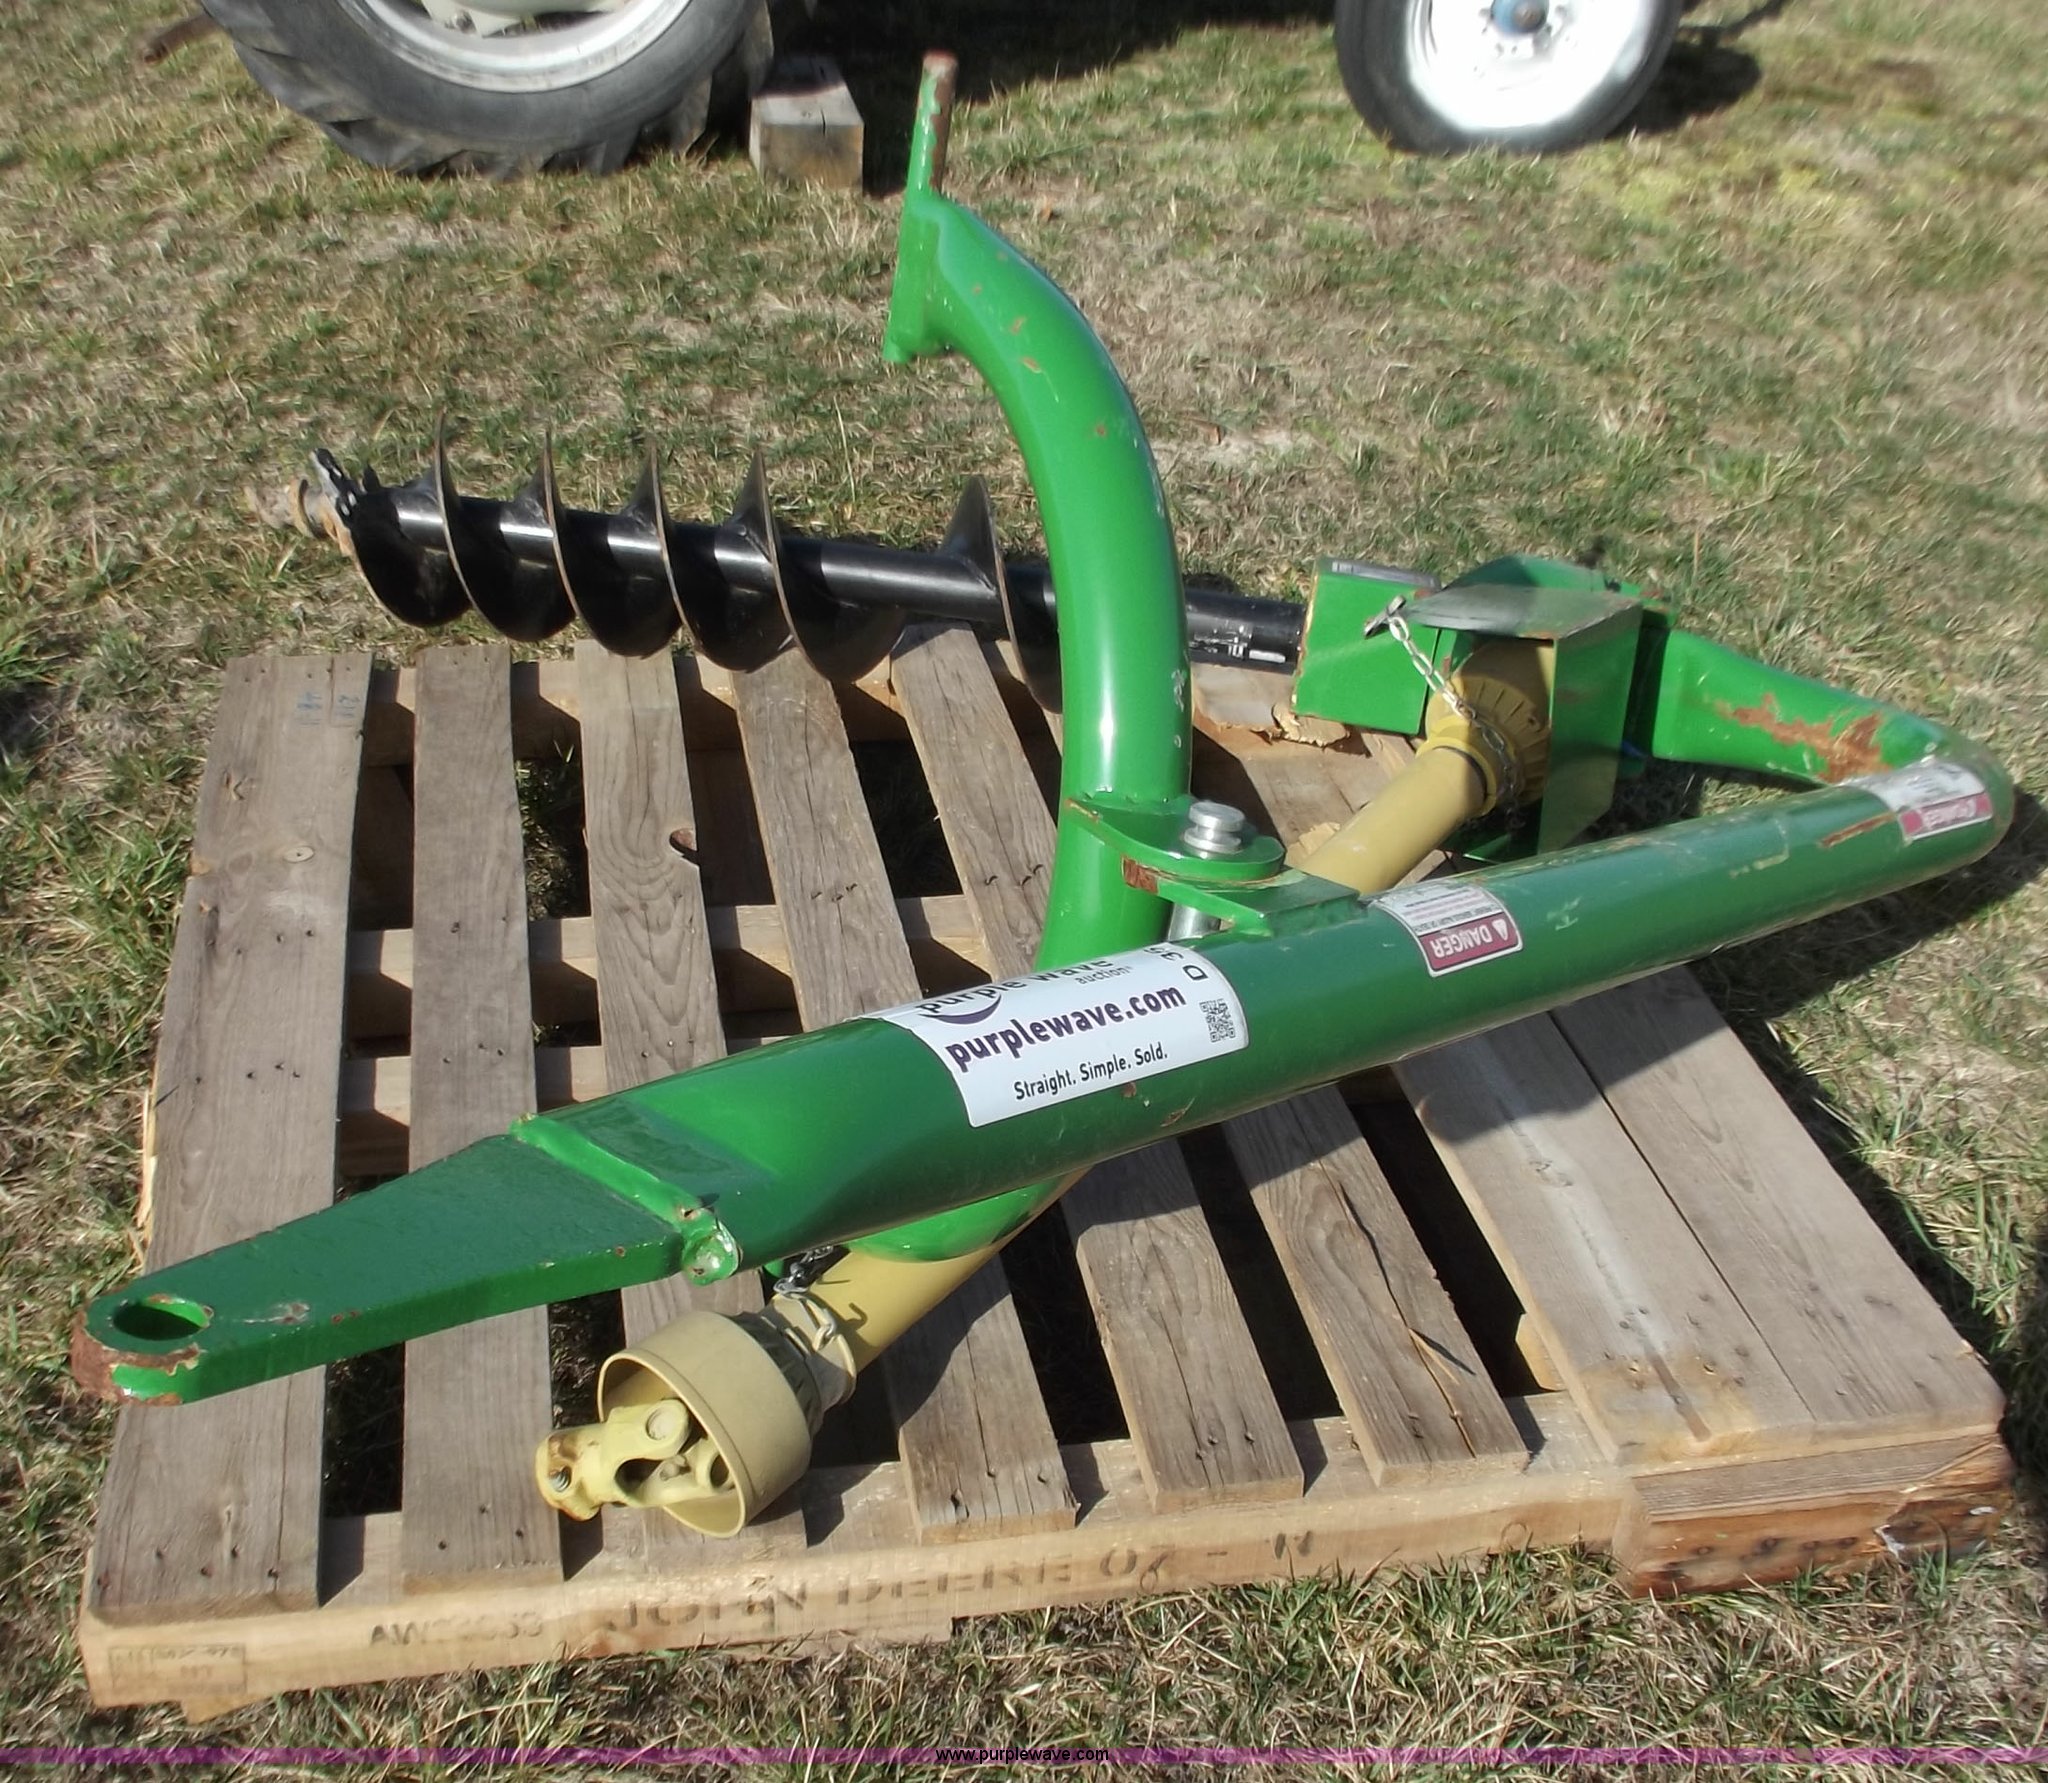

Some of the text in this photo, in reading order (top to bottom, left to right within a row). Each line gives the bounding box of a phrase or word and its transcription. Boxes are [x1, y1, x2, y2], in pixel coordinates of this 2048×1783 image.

[1430, 924, 1493, 958] DANGER
[915, 960, 1114, 1014] purple wave
[945, 984, 1187, 1073] purplewave.com
[1014, 1041, 1168, 1100] Straight. Simple. Sold.
